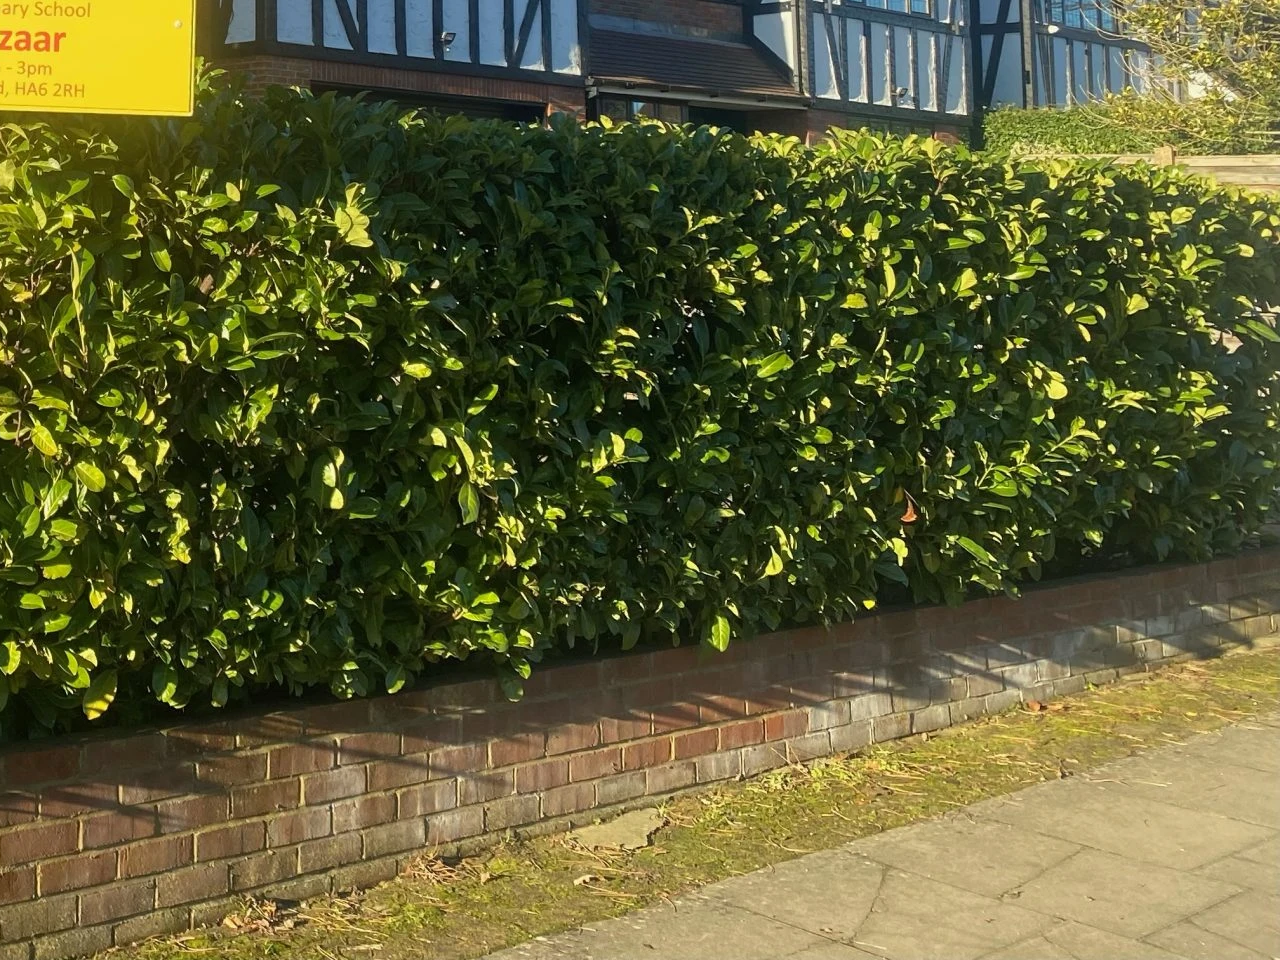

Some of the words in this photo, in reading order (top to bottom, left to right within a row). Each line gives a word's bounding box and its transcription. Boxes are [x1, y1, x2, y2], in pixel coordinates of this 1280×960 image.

[34, 1, 91, 18] School
[16, 61, 52, 78] 3pm
[15, 82, 48, 97] HA6
[52, 83, 85, 98] 2RH
